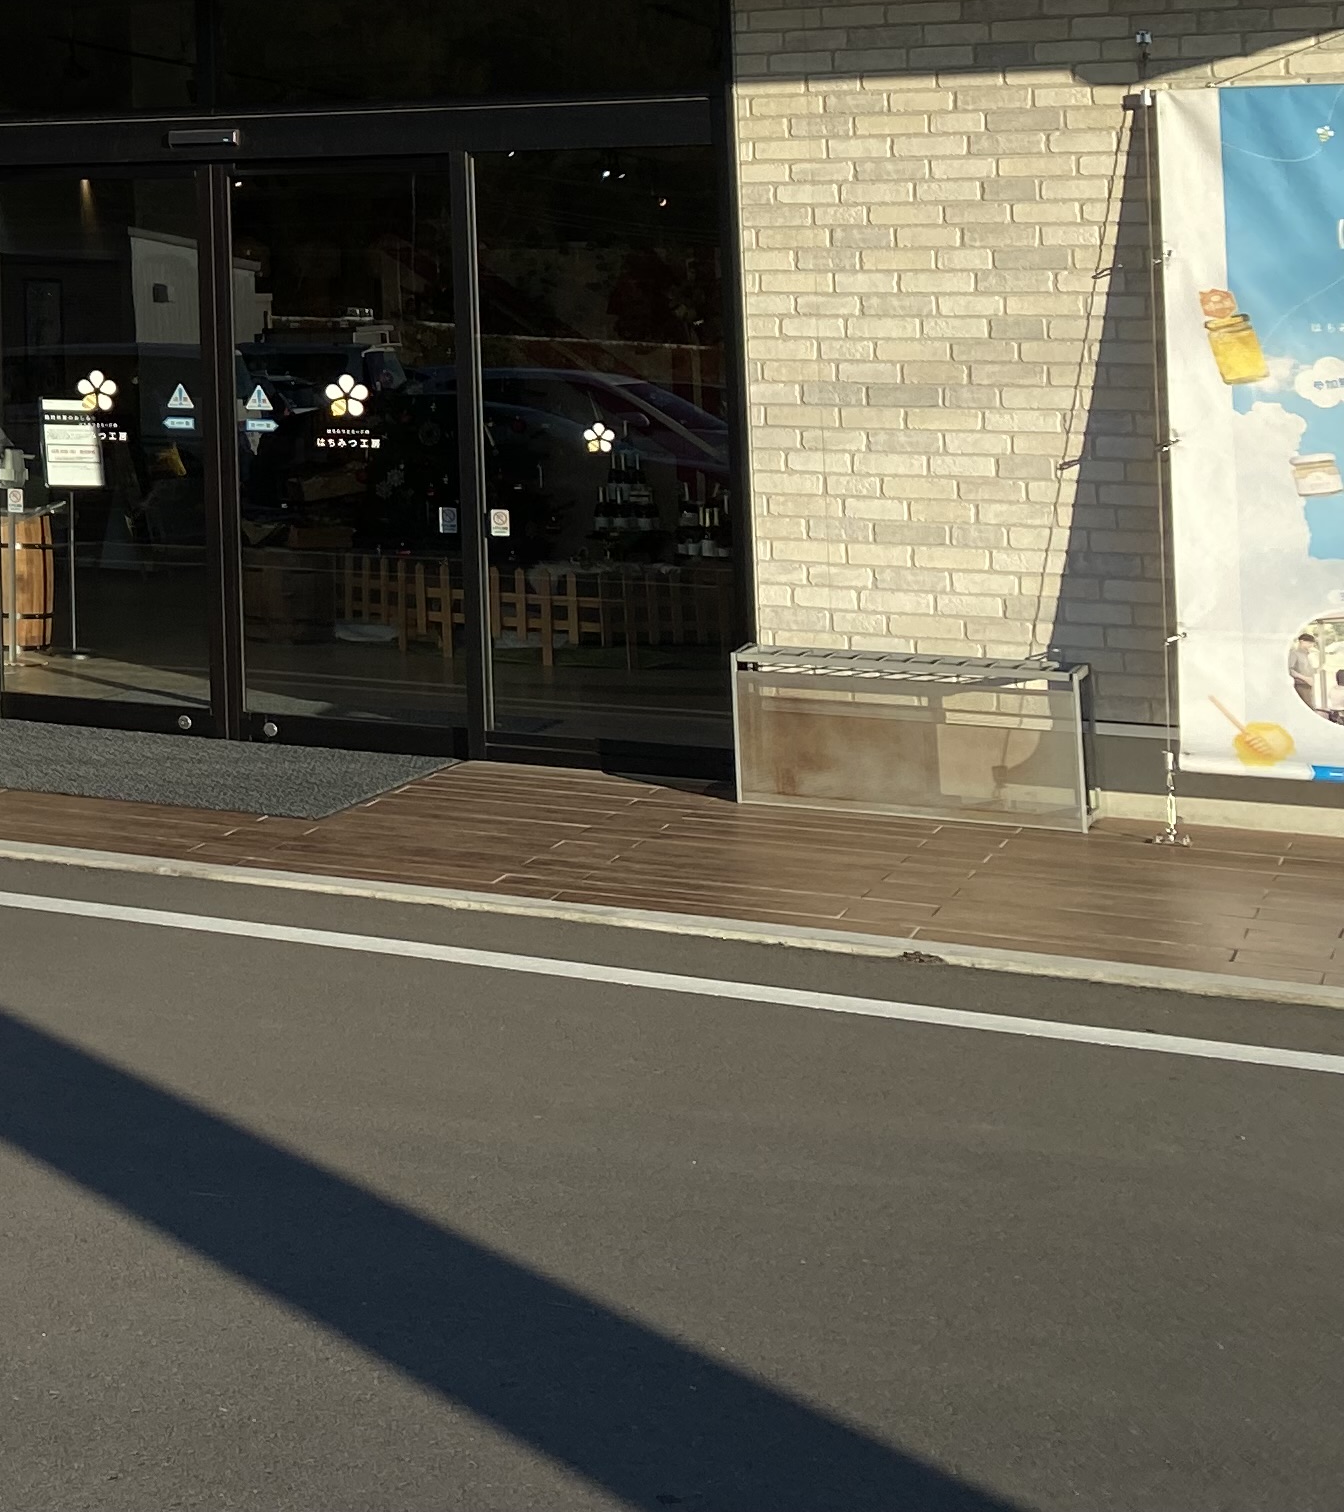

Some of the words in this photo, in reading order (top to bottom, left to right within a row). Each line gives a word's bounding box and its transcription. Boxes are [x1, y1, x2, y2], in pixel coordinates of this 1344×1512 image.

[316, 437, 381, 449] はちみつ工房
